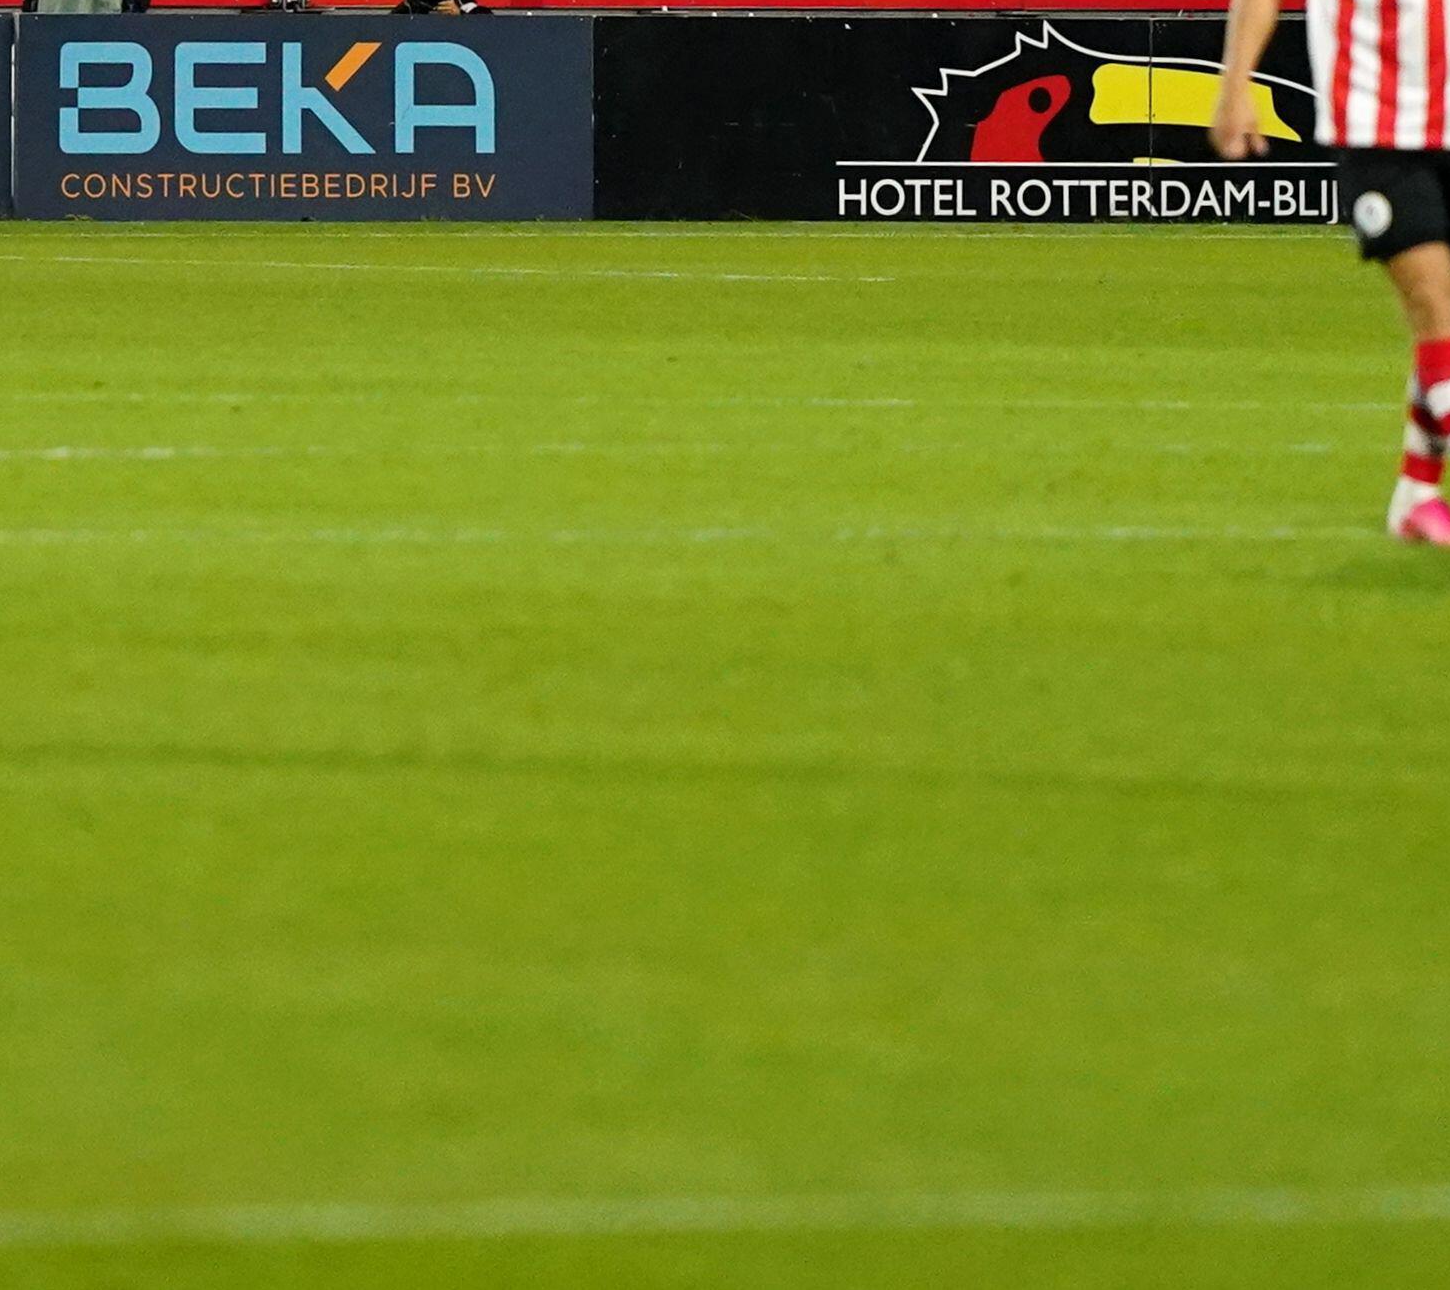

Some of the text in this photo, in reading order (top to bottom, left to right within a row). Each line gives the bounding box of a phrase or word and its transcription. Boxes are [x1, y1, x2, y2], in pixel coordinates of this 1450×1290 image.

[59, 41, 497, 155] BEKA
[60, 172, 497, 200] CONSTRUCTIEBEDRIJF BV
[837, 178, 1340, 225] HOTEL ROTTERDAM-BLIJ
